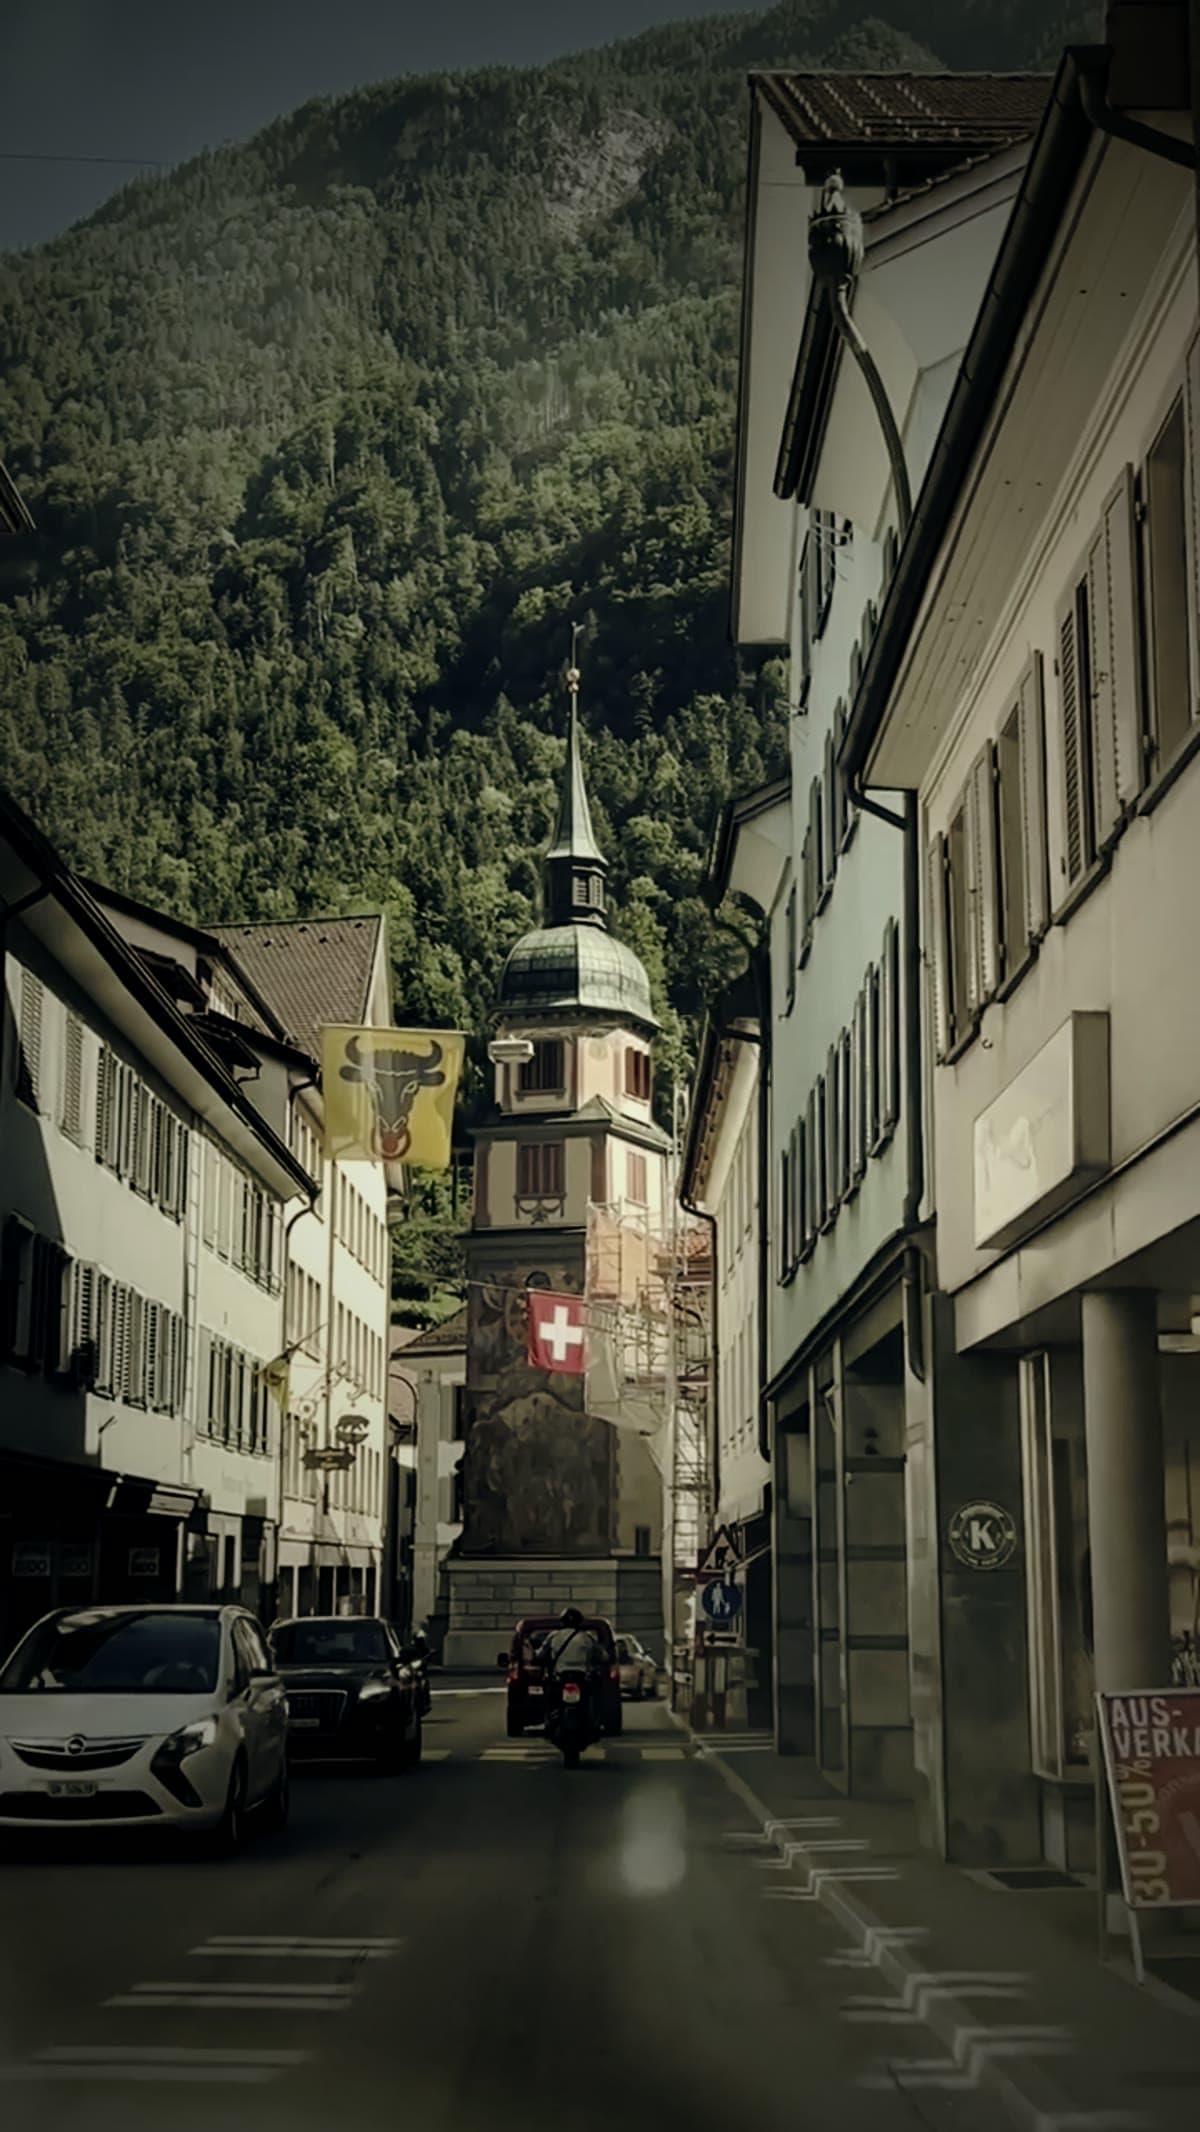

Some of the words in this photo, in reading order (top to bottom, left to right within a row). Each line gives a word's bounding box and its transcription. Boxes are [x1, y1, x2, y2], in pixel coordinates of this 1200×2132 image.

[970, 1519, 996, 1550] K
[1111, 1697, 1183, 1728] AUS-
[1115, 1759, 1171, 1903] 30-50%
